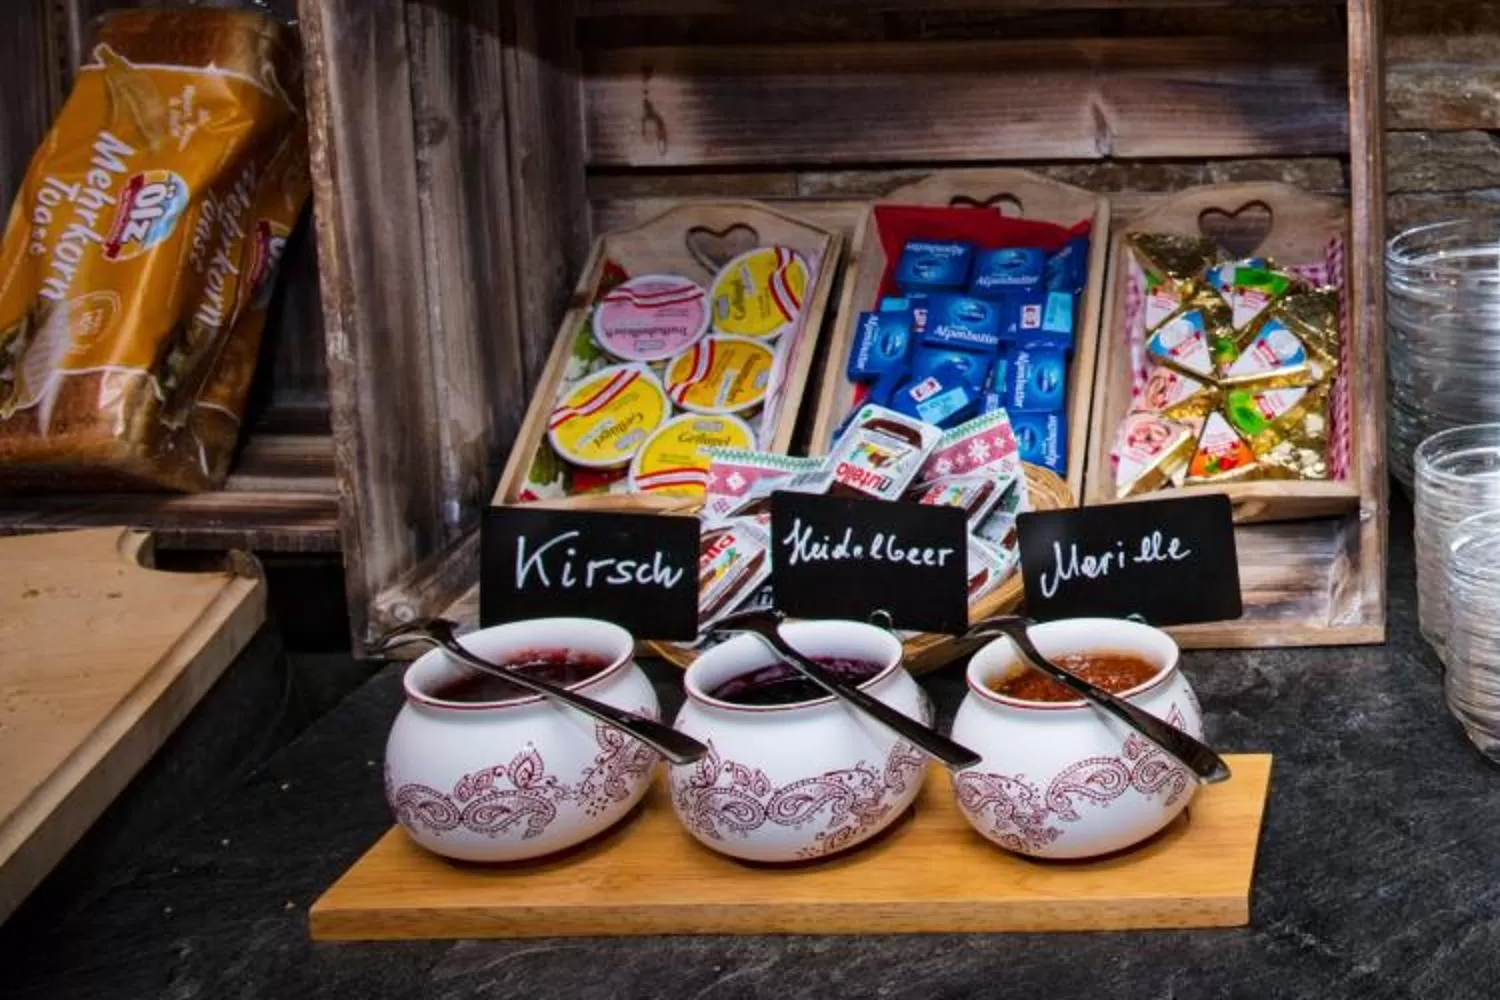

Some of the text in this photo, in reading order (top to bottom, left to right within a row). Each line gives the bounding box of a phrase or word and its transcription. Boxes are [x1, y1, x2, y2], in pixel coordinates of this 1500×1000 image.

[39, 130, 136, 302] Mehrkorn
[120, 175, 176, 247] Ölz
[835, 461, 894, 492] nutella
[516, 530, 684, 589] Kirsch
[1039, 530, 1192, 598] Marille
